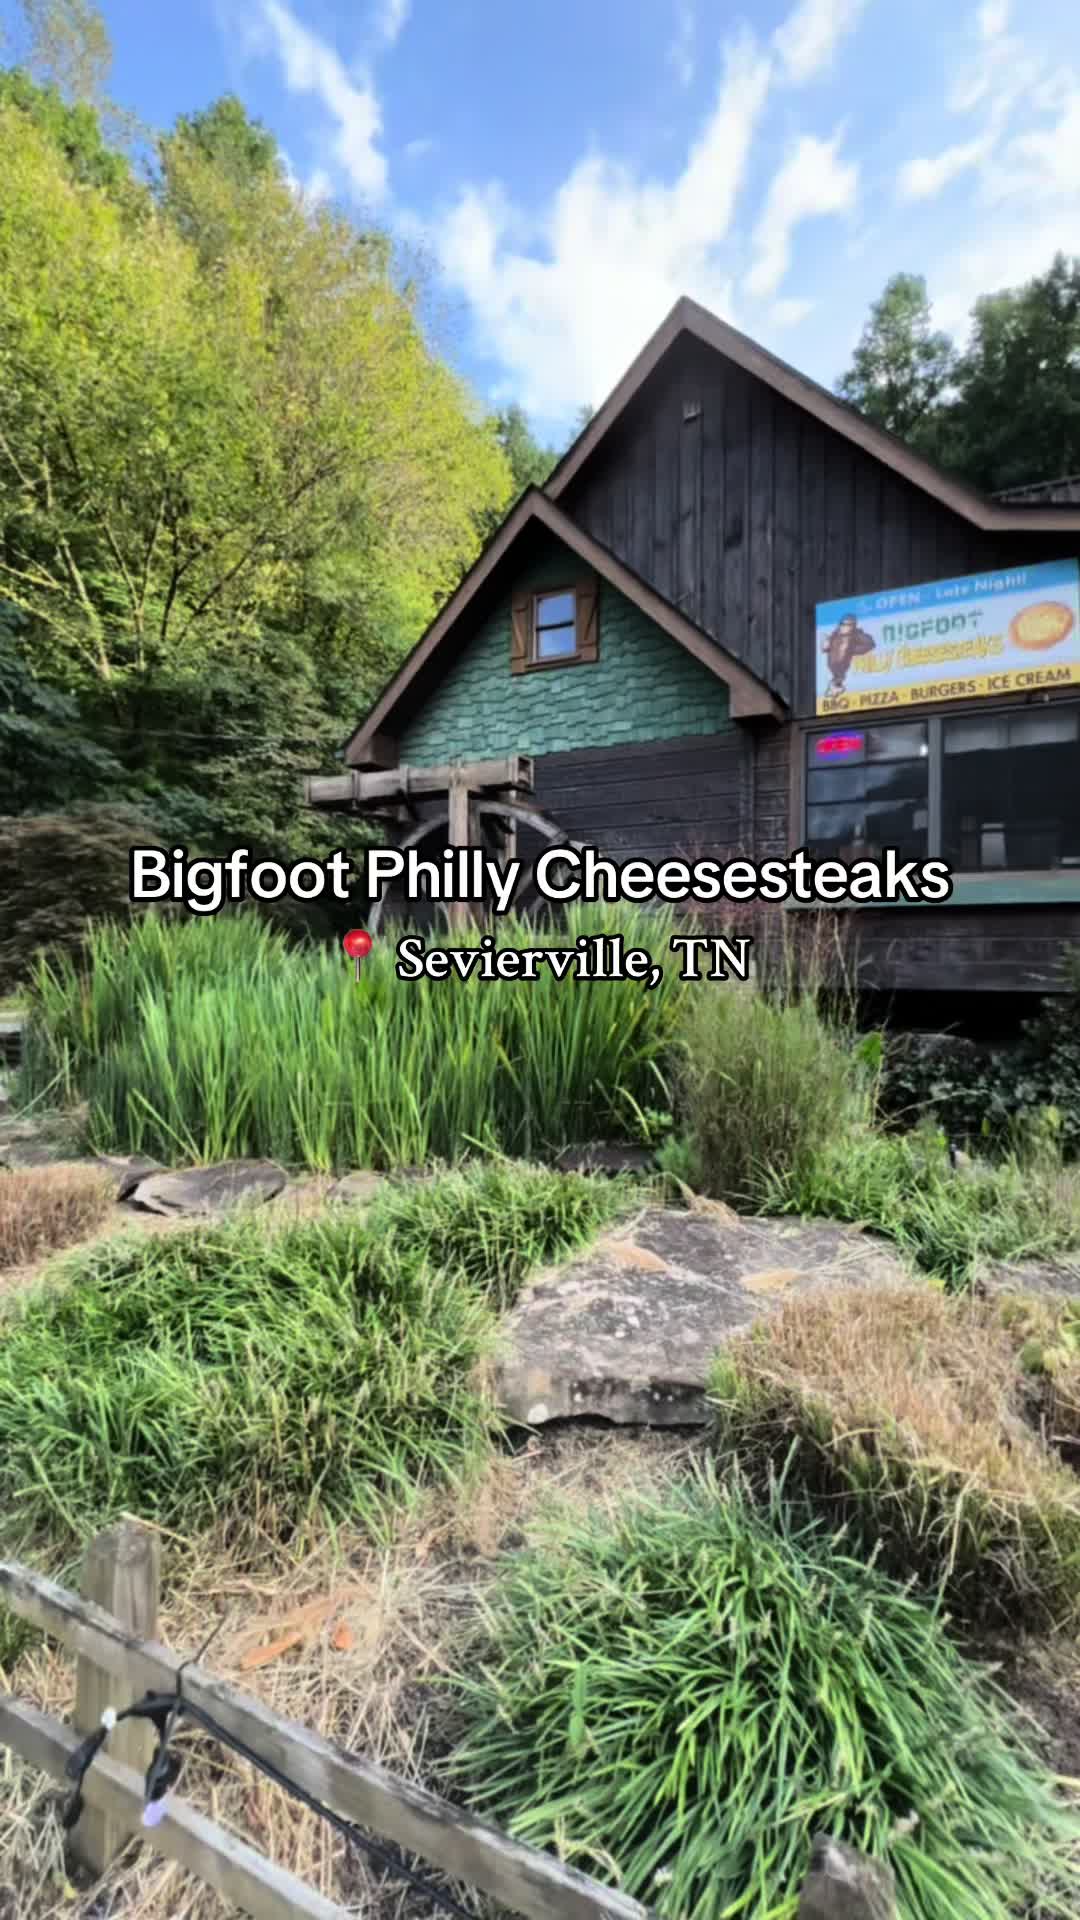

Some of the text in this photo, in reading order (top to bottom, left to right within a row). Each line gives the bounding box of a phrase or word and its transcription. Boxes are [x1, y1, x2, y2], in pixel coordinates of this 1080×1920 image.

[876, 592, 920, 609] OPEN
[823, 668, 1071, 712] BBQ PIZZA BURGERS ICE CREAM
